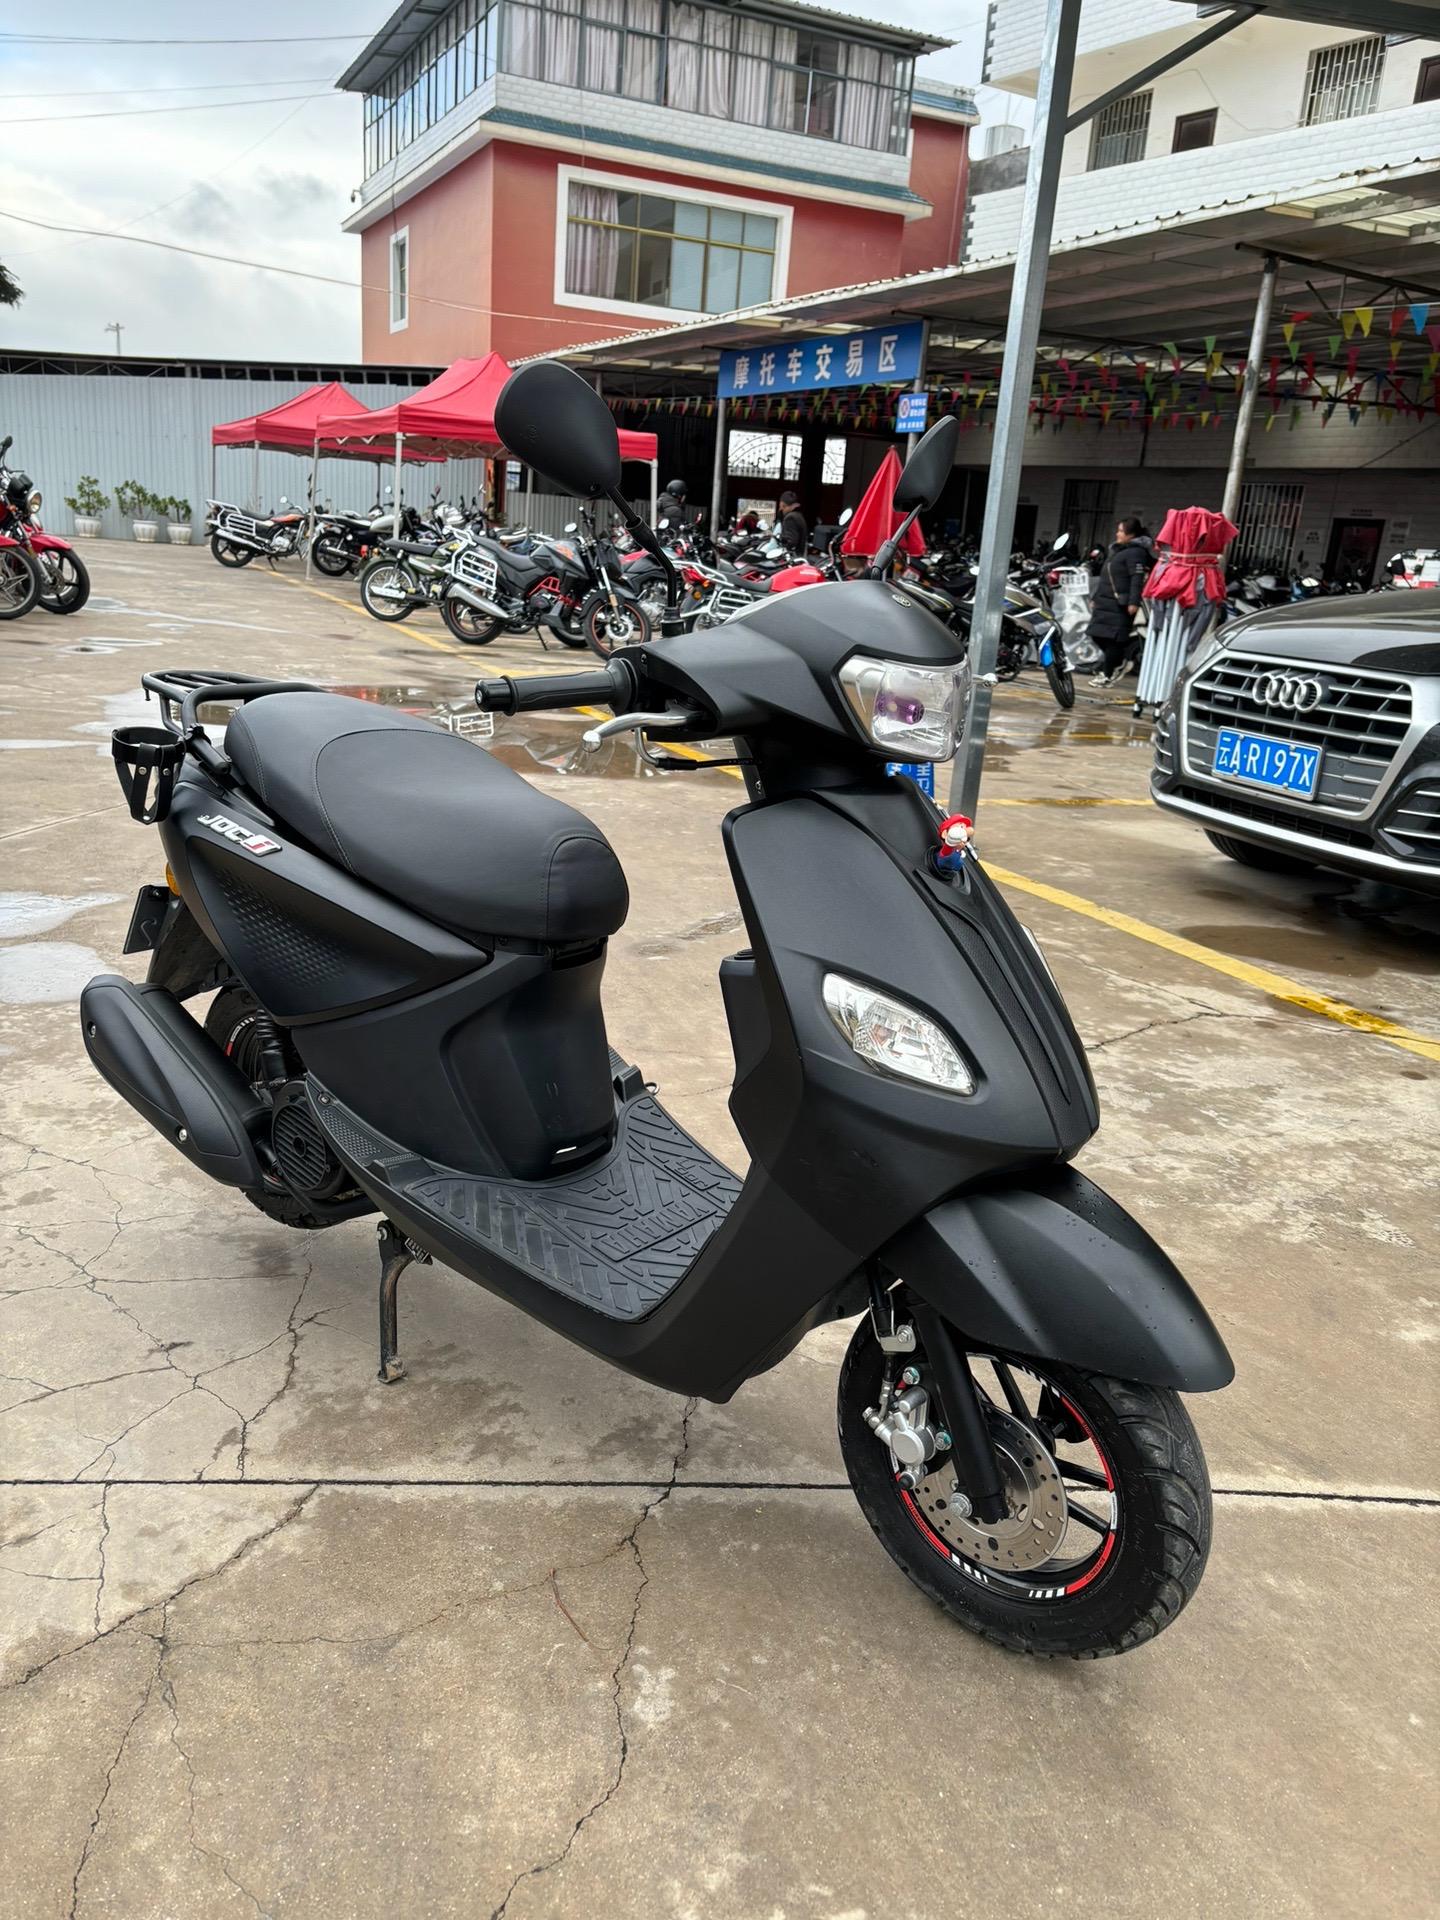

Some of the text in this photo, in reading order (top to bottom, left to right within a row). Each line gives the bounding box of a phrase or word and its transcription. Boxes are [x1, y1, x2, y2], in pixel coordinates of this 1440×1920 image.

[733, 334, 898, 389] 摩托车交易区
[601, 1200, 710, 1255] YAMAHA
